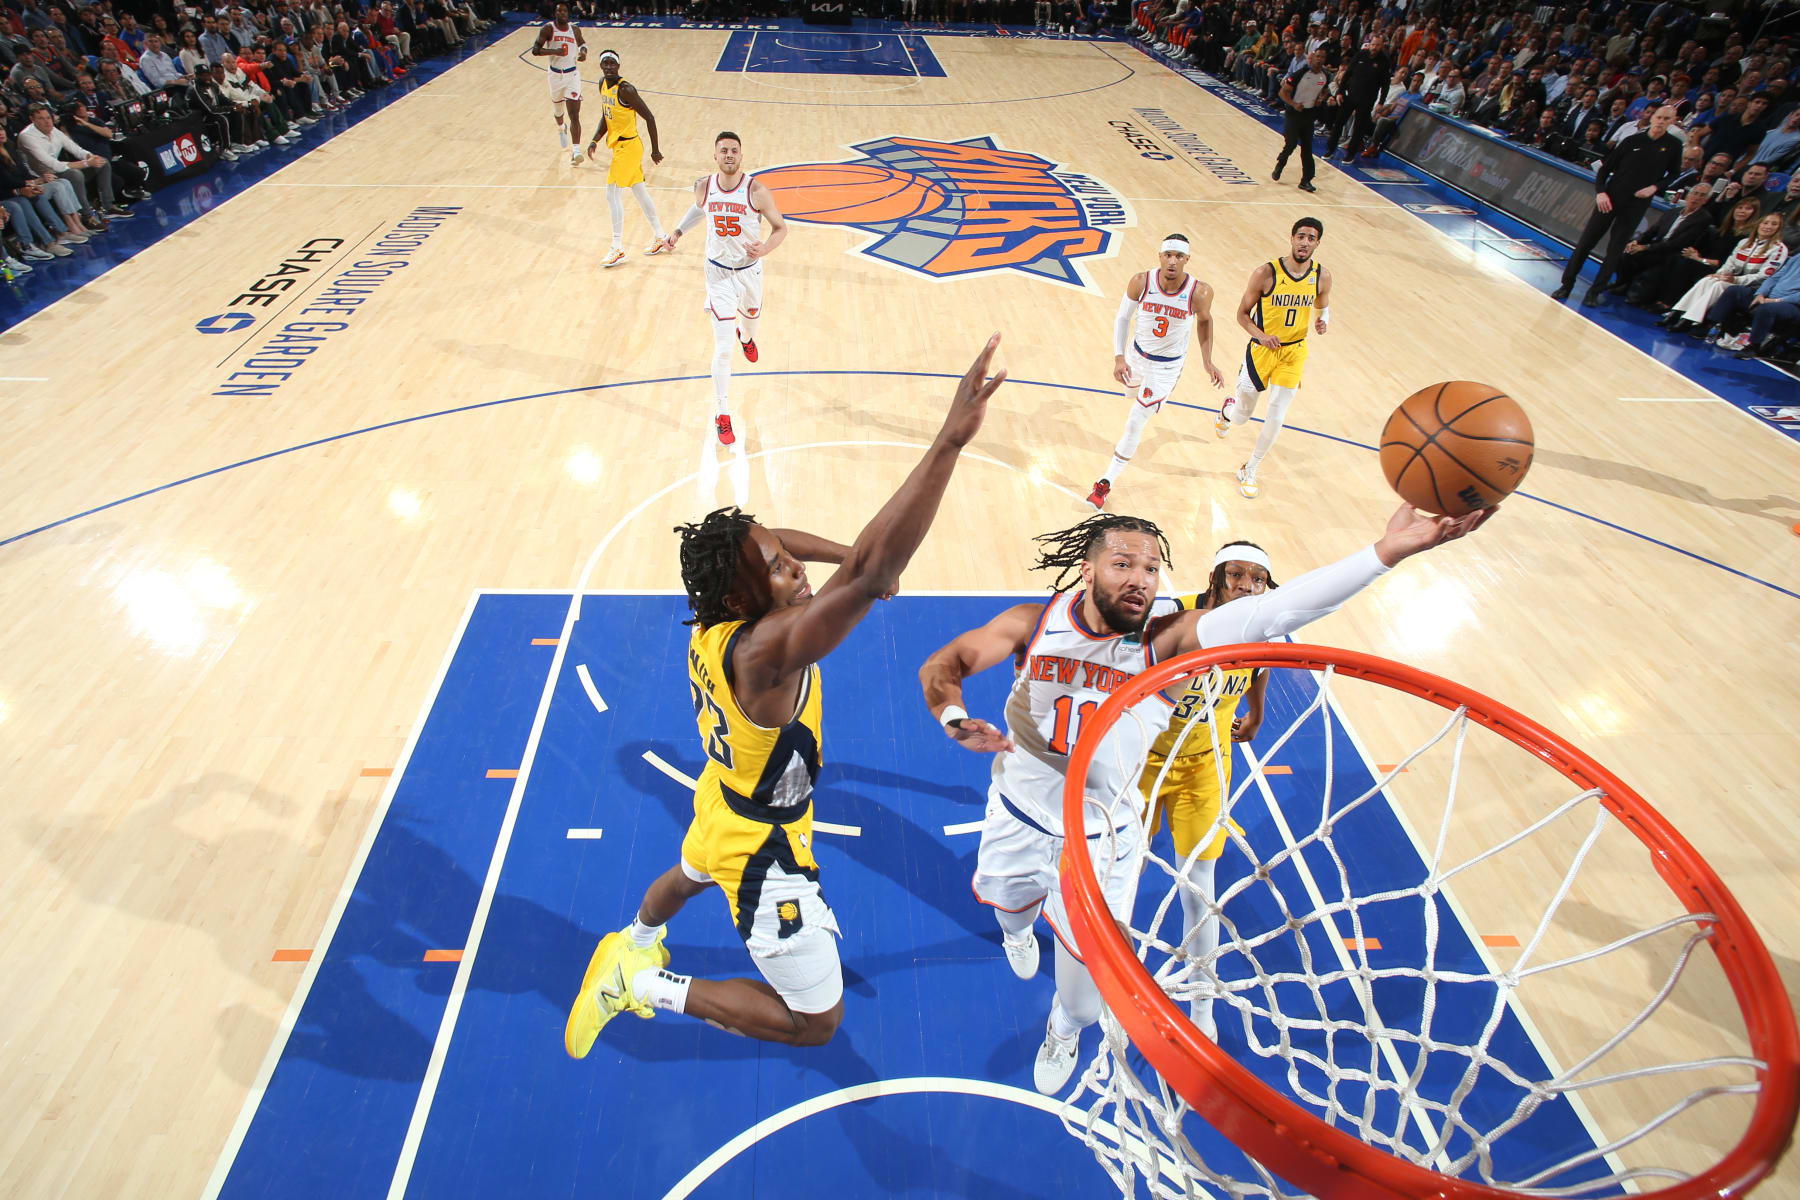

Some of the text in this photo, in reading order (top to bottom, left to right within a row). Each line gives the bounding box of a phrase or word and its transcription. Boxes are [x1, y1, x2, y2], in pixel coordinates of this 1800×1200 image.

[1108, 120, 1161, 150] CHASE
[1194, 157, 1260, 185] GARDEN
[708, 201, 748, 216] NEW YORK
[888, 136, 1104, 276] KNICKS
[1051, 172, 1126, 226] NEW YORK
[713, 215, 741, 237] 55
[227, 238, 344, 308] CHASE
[211, 206, 463, 396] MADISON SQUARE GARDEN
[1142, 302, 1189, 320] NEW YORK
[1271, 294, 1314, 307] INDIANA
[1152, 316, 1170, 338] 3
[1284, 308, 1297, 328] 0
[1029, 655, 1135, 694] NEW YOR
[1048, 694, 1100, 756] 11
